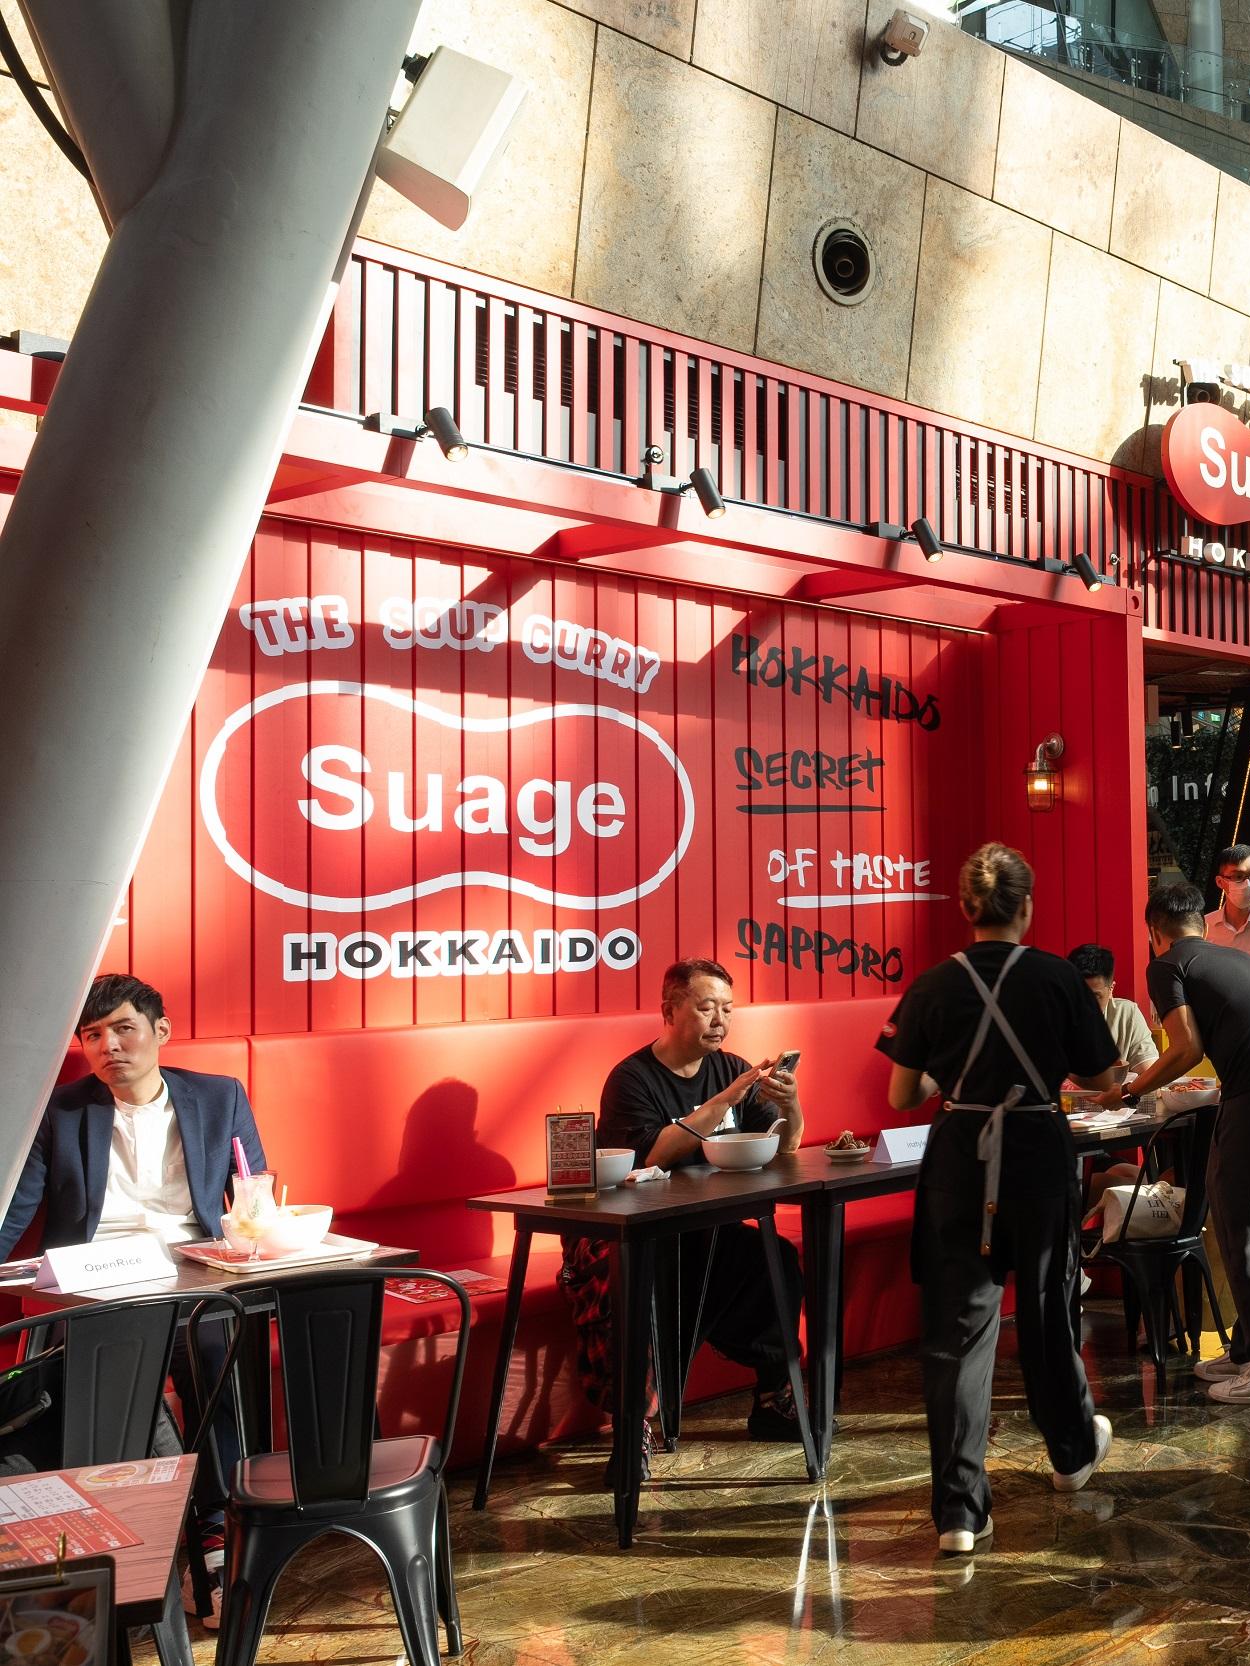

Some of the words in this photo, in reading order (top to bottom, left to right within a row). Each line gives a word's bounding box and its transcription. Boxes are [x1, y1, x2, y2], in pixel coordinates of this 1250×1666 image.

[241, 596, 353, 655] THE
[381, 597, 508, 651] SOUP
[523, 615, 659, 692] CURRY
[732, 633, 940, 731] HOKKAIDO
[735, 747, 885, 792] SECRET
[298, 745, 625, 856] Suage
[768, 848, 816, 888] OF
[286, 932, 638, 977] HOKKAIDO
[735, 918, 903, 982] SAPPORO
[84, 1256, 142, 1272] OpenRice
